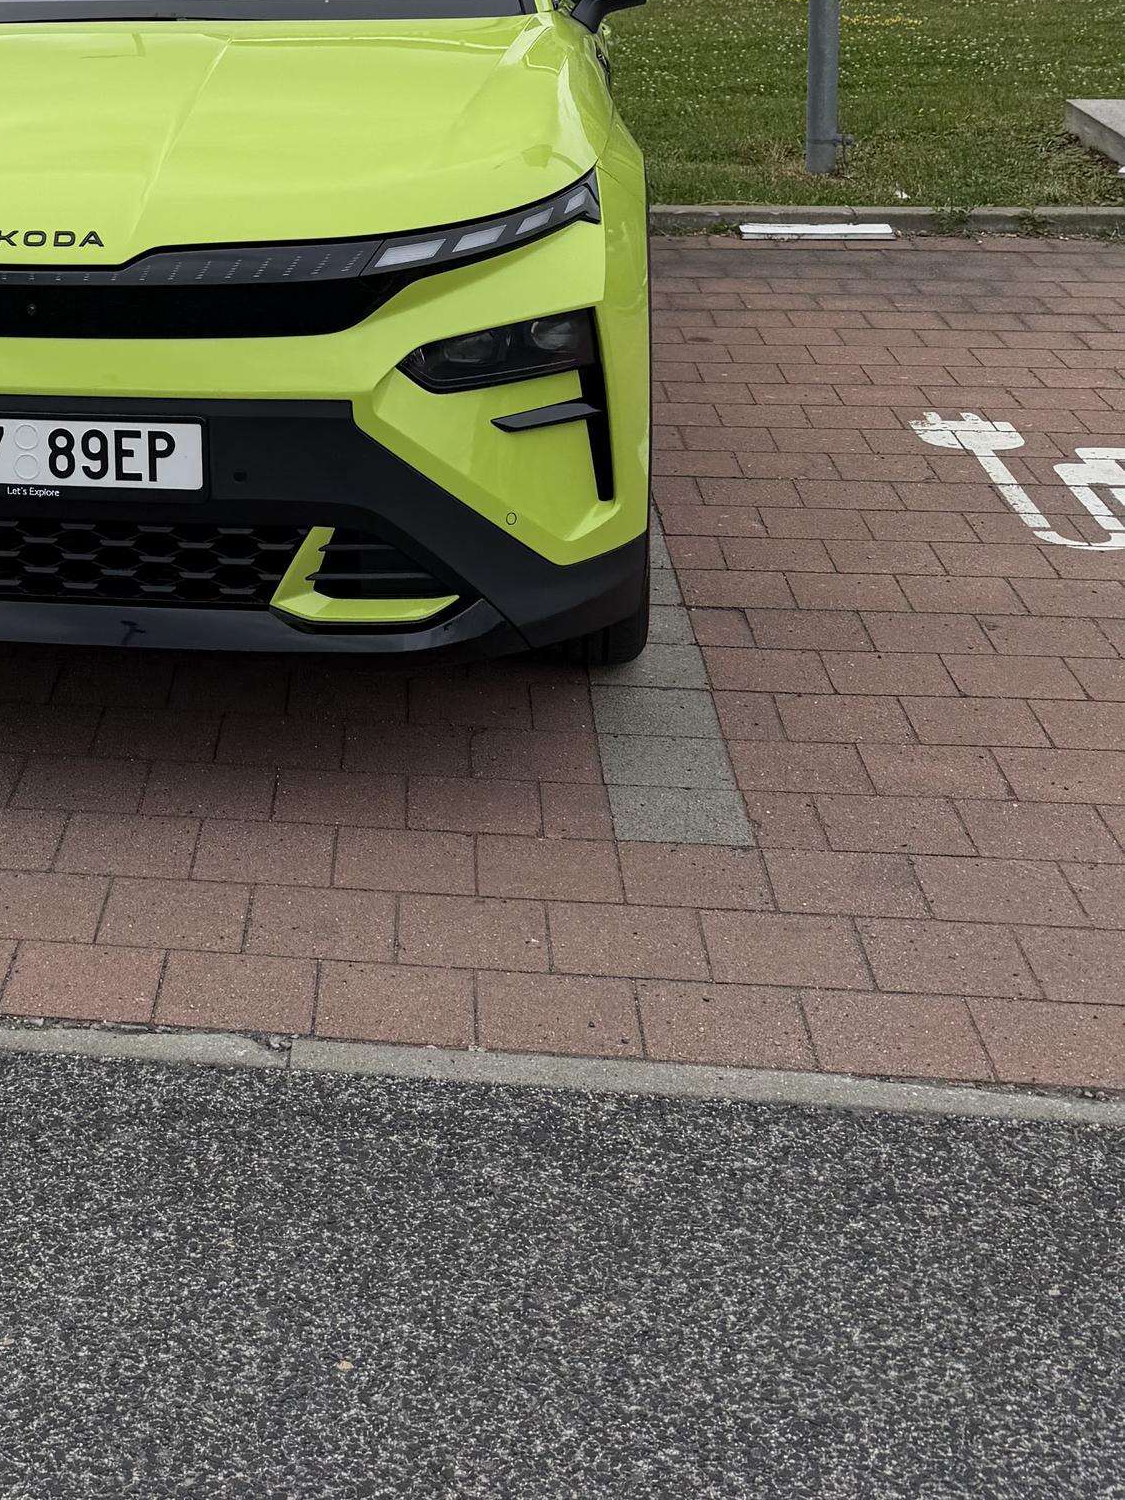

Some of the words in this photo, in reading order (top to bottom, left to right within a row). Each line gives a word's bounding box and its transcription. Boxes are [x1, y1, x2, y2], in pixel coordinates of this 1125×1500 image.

[47, 427, 176, 482] 89EP
[7, 485, 28, 497] Let's
[29, 486, 60, 499] Explore
